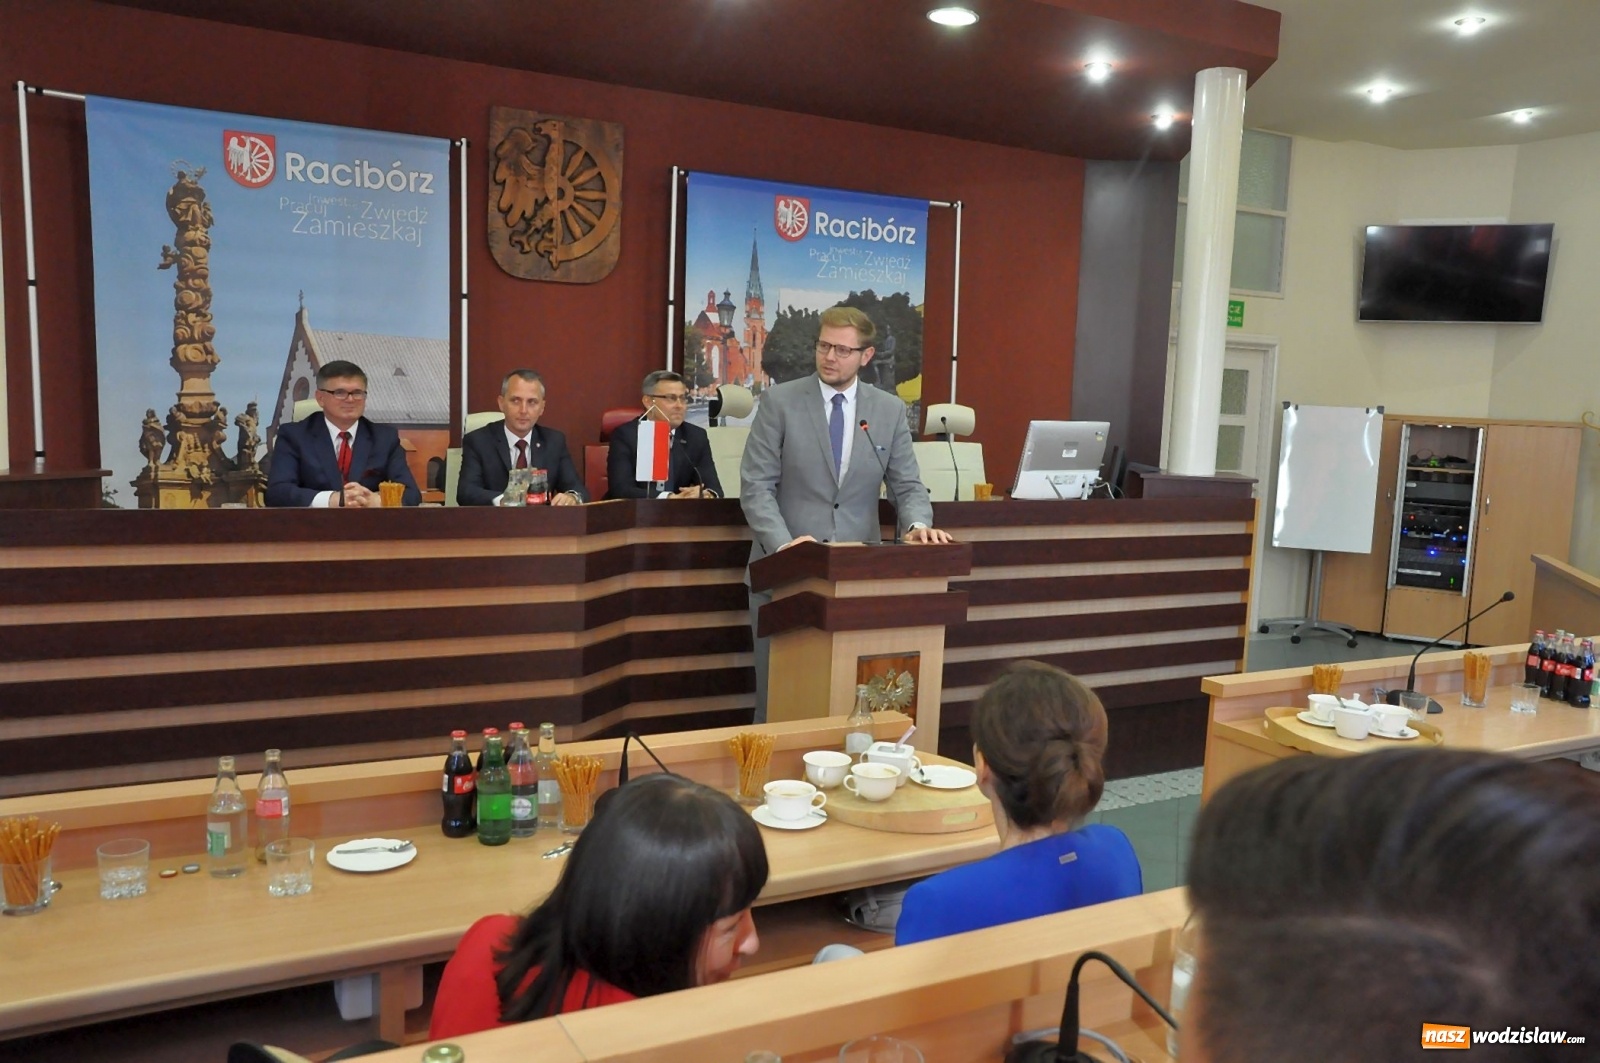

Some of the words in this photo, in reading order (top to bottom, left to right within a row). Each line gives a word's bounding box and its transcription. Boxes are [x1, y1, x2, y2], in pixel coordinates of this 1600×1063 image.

[284, 151, 435, 195] Racibórz
[291, 210, 422, 248] Zamieszkaj
[815, 211, 916, 245] Racibórz
[816, 259, 906, 288] Zamieszkaj
